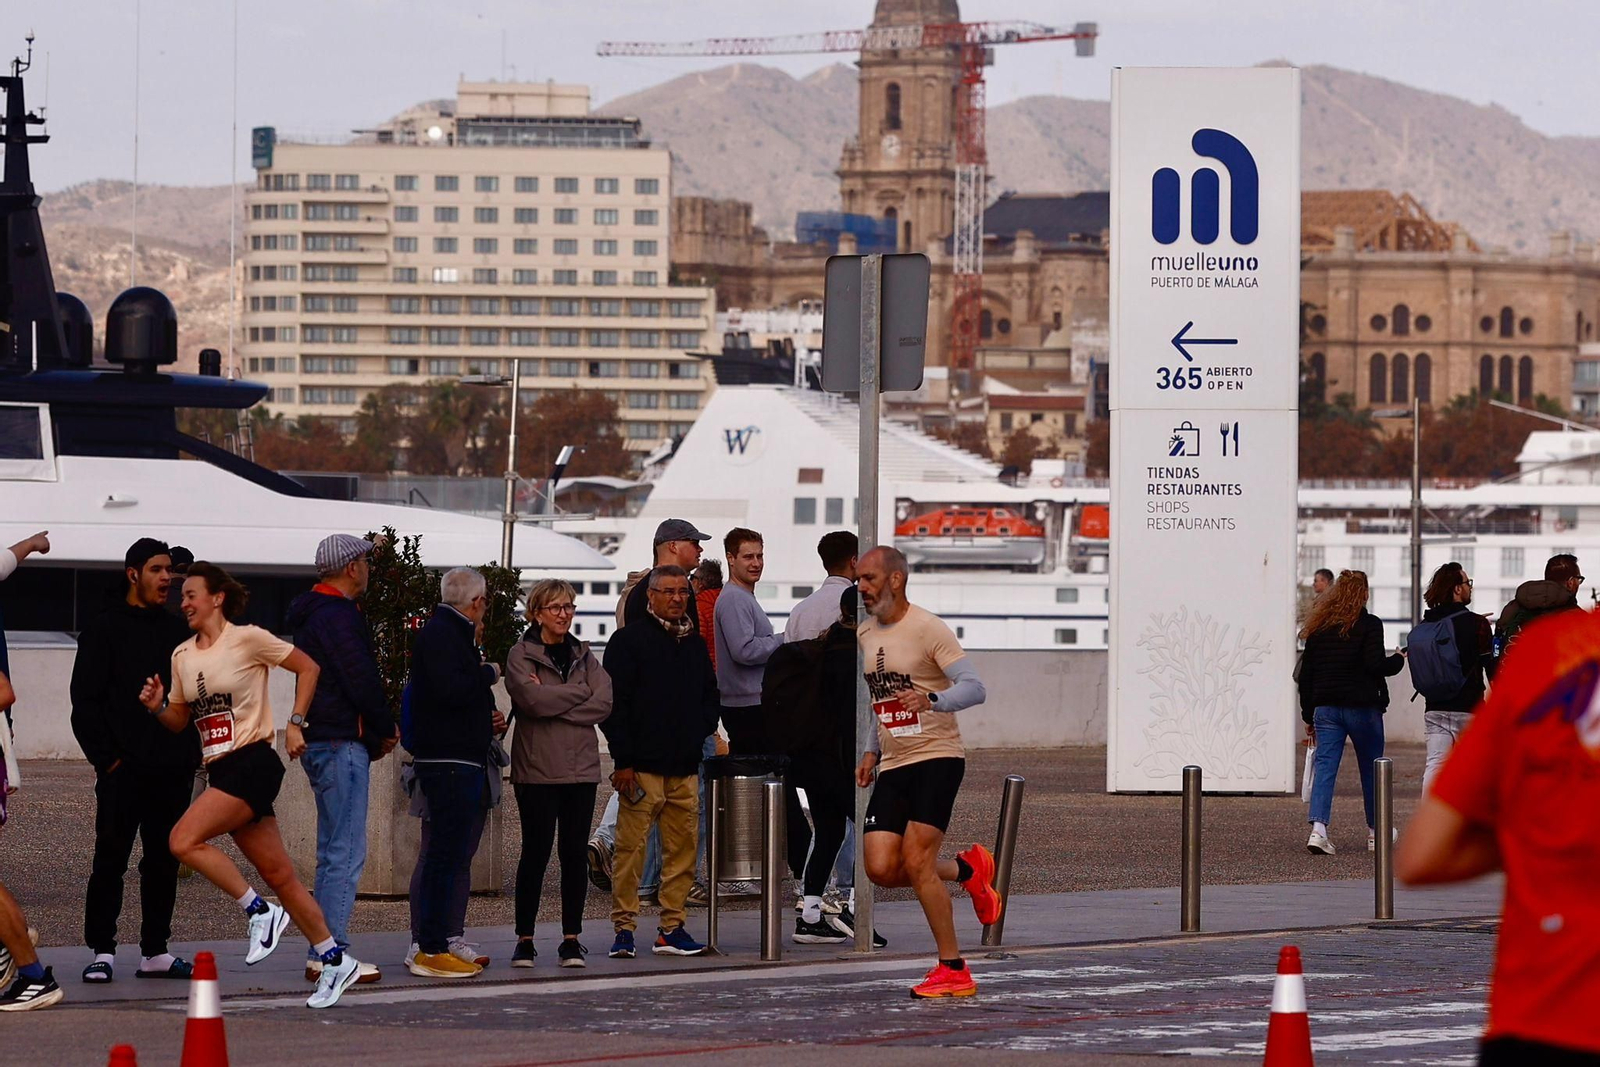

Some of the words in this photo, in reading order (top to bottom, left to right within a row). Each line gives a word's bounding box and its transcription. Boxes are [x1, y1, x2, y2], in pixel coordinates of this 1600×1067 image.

[1151, 252, 1259, 271] muelleuno
[1151, 277, 1194, 288] PUERTO
[1197, 277, 1211, 288] DE
[1214, 275, 1259, 288] MÁLAGA
[1156, 367, 1203, 390] 365
[1206, 367, 1253, 376] ABIERTO
[1207, 381, 1244, 390] OPEN
[1147, 467, 1200, 479] TIENDAS
[1147, 484, 1242, 496] RESTAURANTES
[1147, 501, 1190, 513] SHOPS
[1147, 518, 1236, 530] RESTAURANTS
[895, 710, 913, 721] 599
[210, 726, 229, 739] 329
